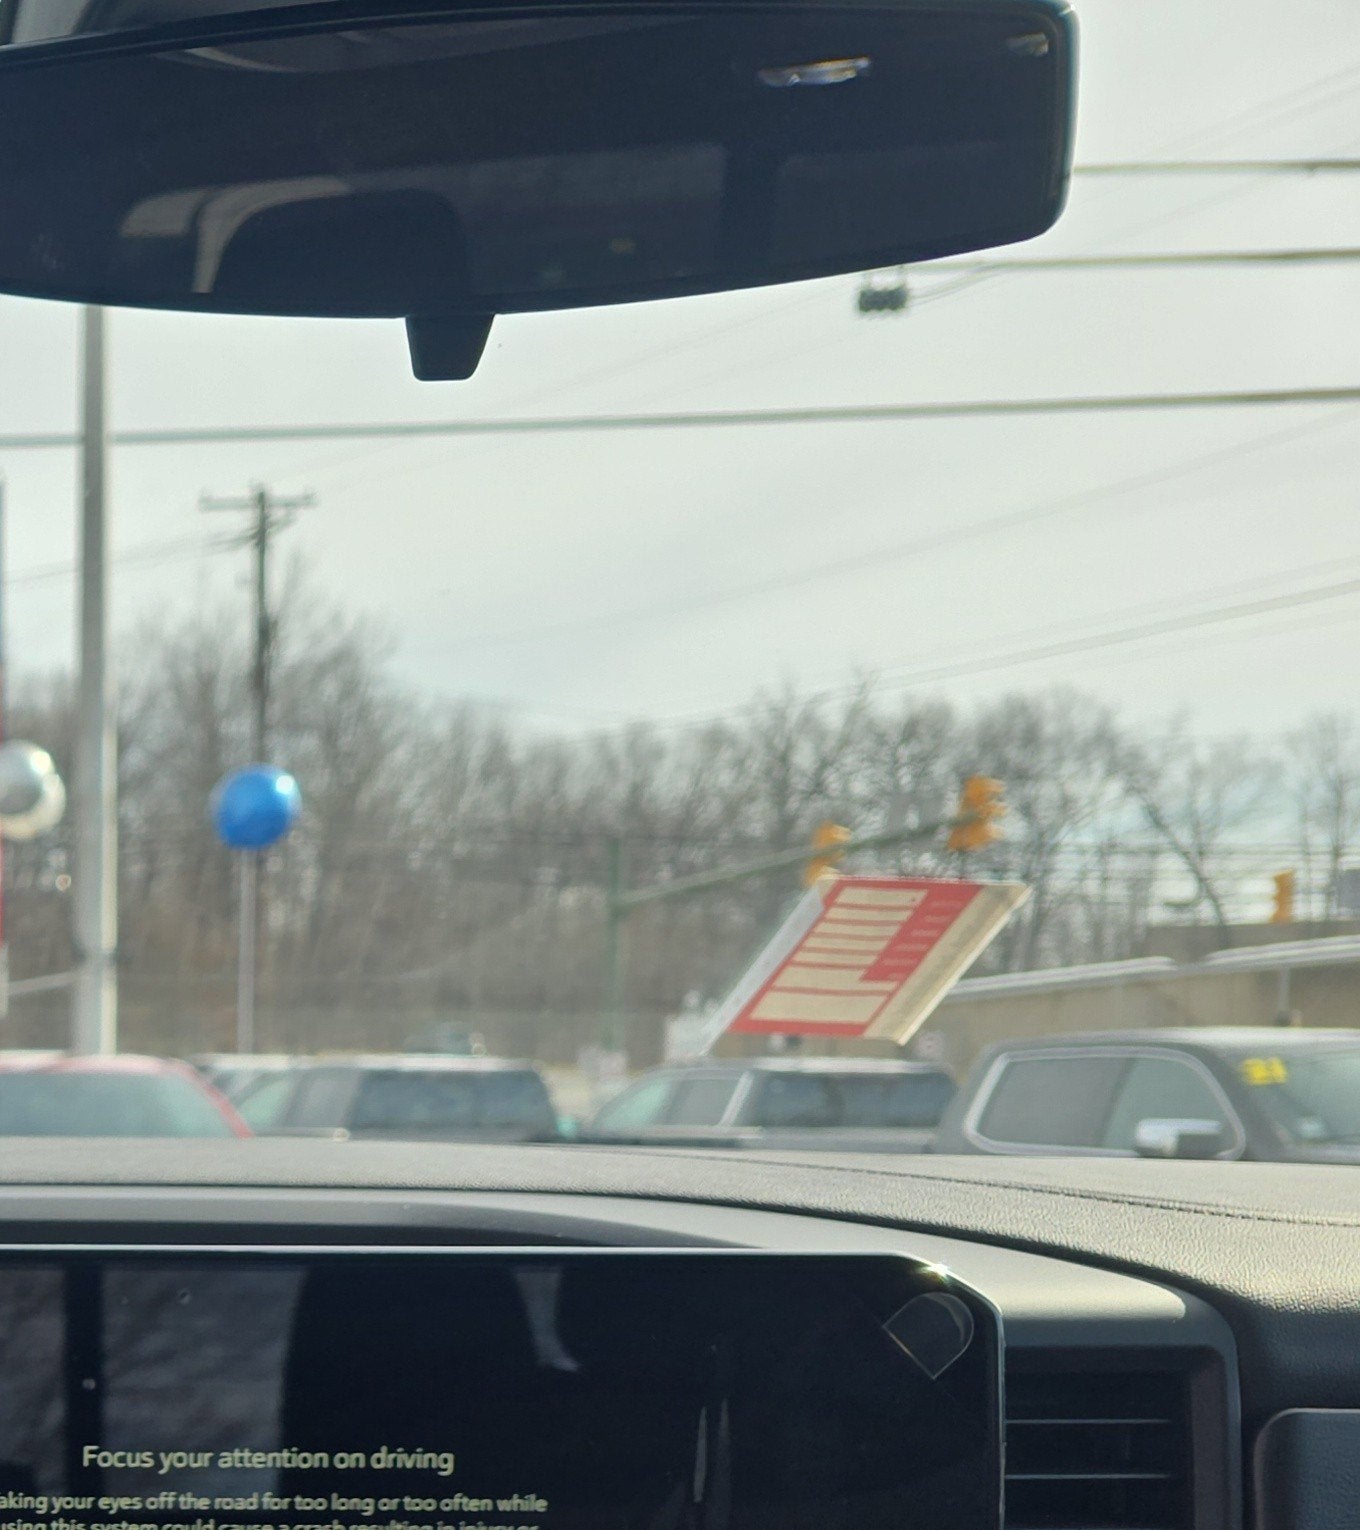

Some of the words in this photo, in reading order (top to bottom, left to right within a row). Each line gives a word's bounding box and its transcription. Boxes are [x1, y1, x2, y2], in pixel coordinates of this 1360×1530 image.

[83, 1445, 154, 1468] Focus
[158, 1452, 214, 1475] your
[218, 1448, 329, 1469] attention
[333, 1452, 366, 1469] on
[370, 1445, 455, 1476] driving
[50, 1496, 95, 1513] your
[98, 1496, 142, 1514] eyes
[145, 1492, 177, 1510] off
[179, 1492, 211, 1510] the
[214, 1493, 259, 1510] road
[262, 1491, 292, 1511] for
[294, 1493, 328, 1511] too
[331, 1492, 375, 1516] long
[377, 1498, 401, 1511] or
[403, 1495, 437, 1511] too
[439, 1493, 493, 1512] often
[497, 1493, 548, 1512] while
